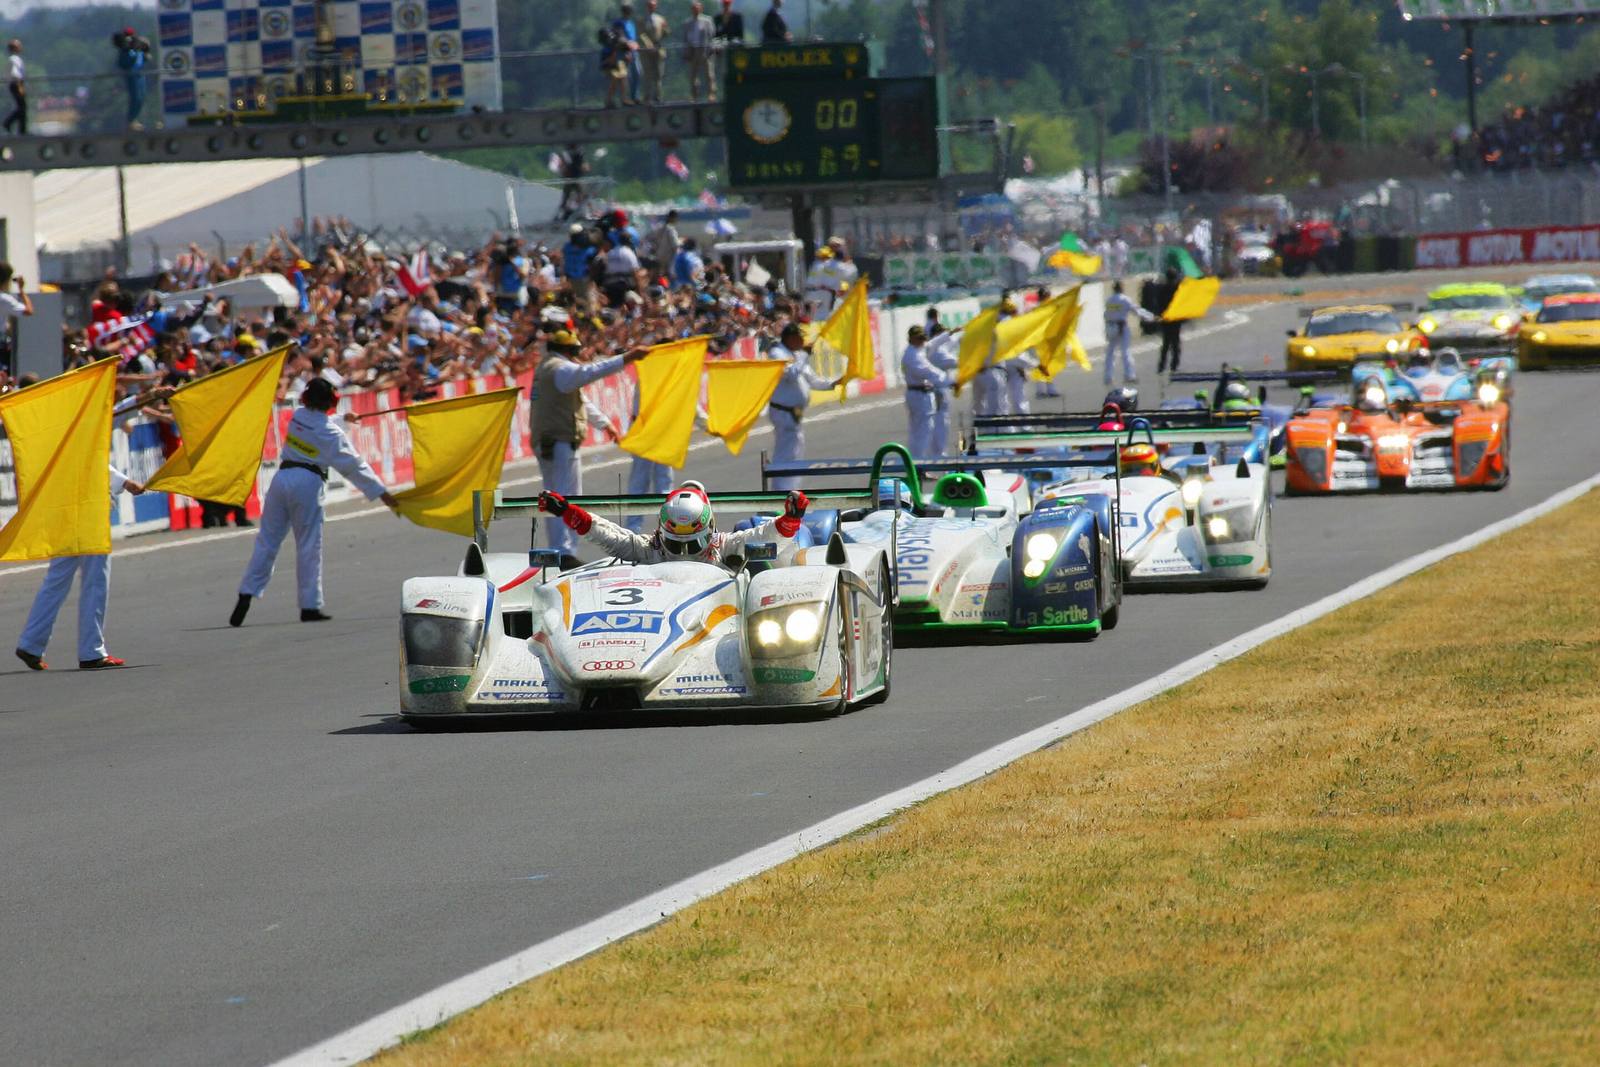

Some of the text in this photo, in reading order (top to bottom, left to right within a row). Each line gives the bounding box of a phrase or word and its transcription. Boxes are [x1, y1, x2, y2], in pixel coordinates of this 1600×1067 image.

[761, 51, 832, 67] ROLEX
[605, 588, 645, 605] 3
[1015, 604, 1088, 625] La Sarthe
[573, 613, 664, 634] ADT
[493, 679, 549, 687] MAHLE
[676, 673, 734, 683] MAHLE
[681, 686, 743, 695] MICHELIN
